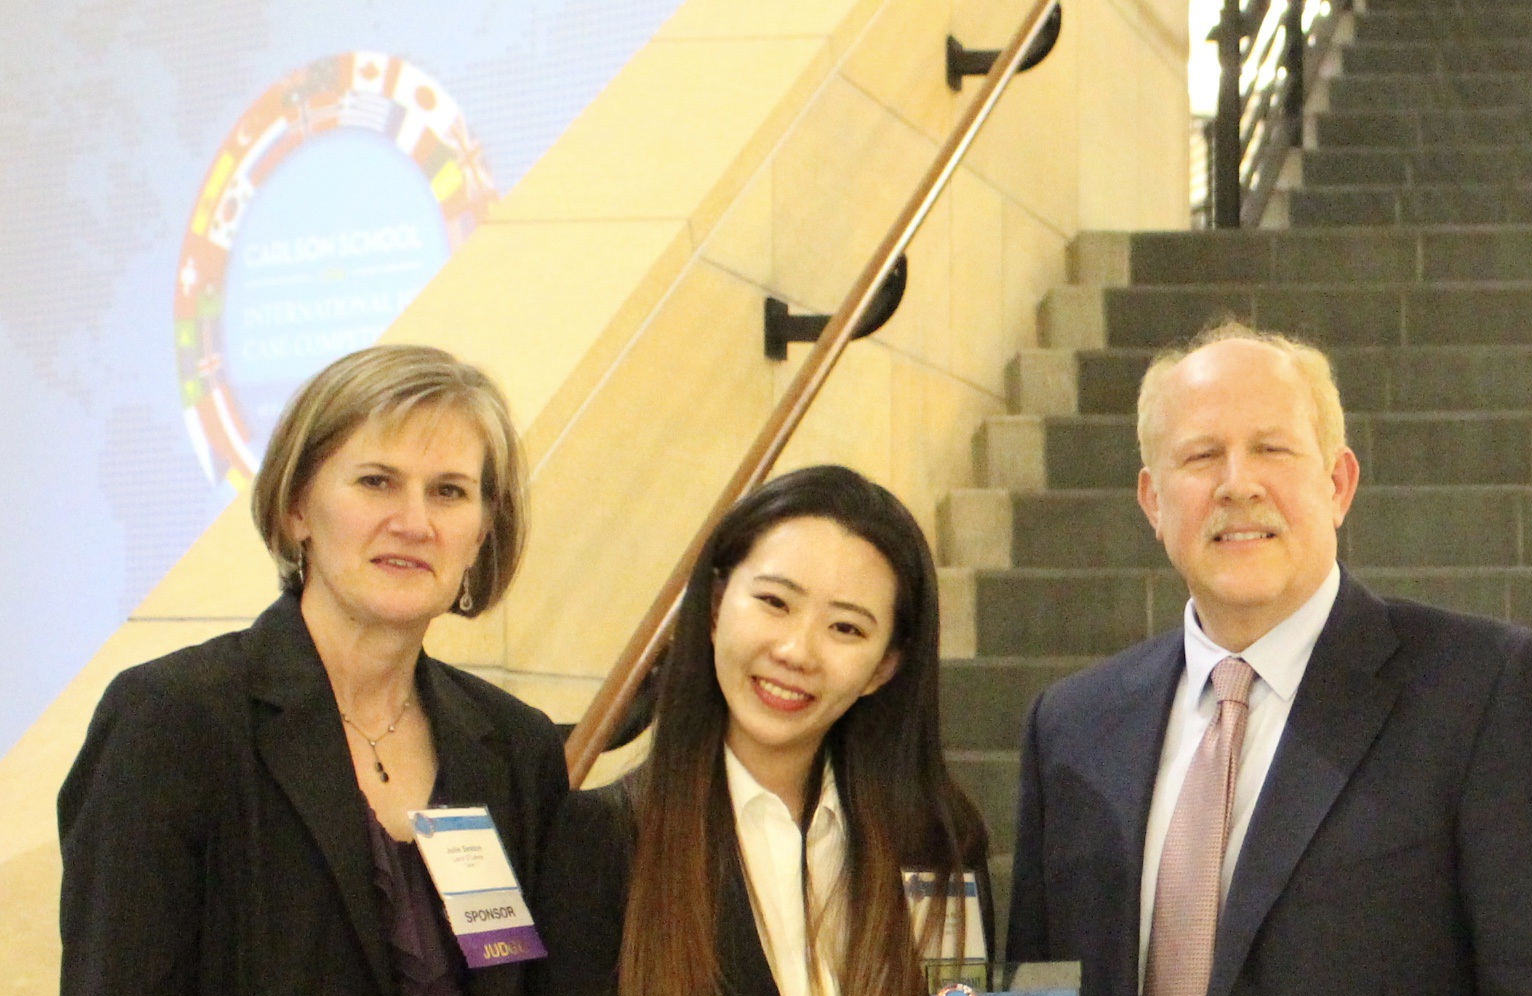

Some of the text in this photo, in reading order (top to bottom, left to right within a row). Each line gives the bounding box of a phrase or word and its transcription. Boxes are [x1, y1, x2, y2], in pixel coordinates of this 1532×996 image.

[245, 225, 423, 267] CARLSON SCHOOL
[464, 906, 516, 923] SPONSOR
